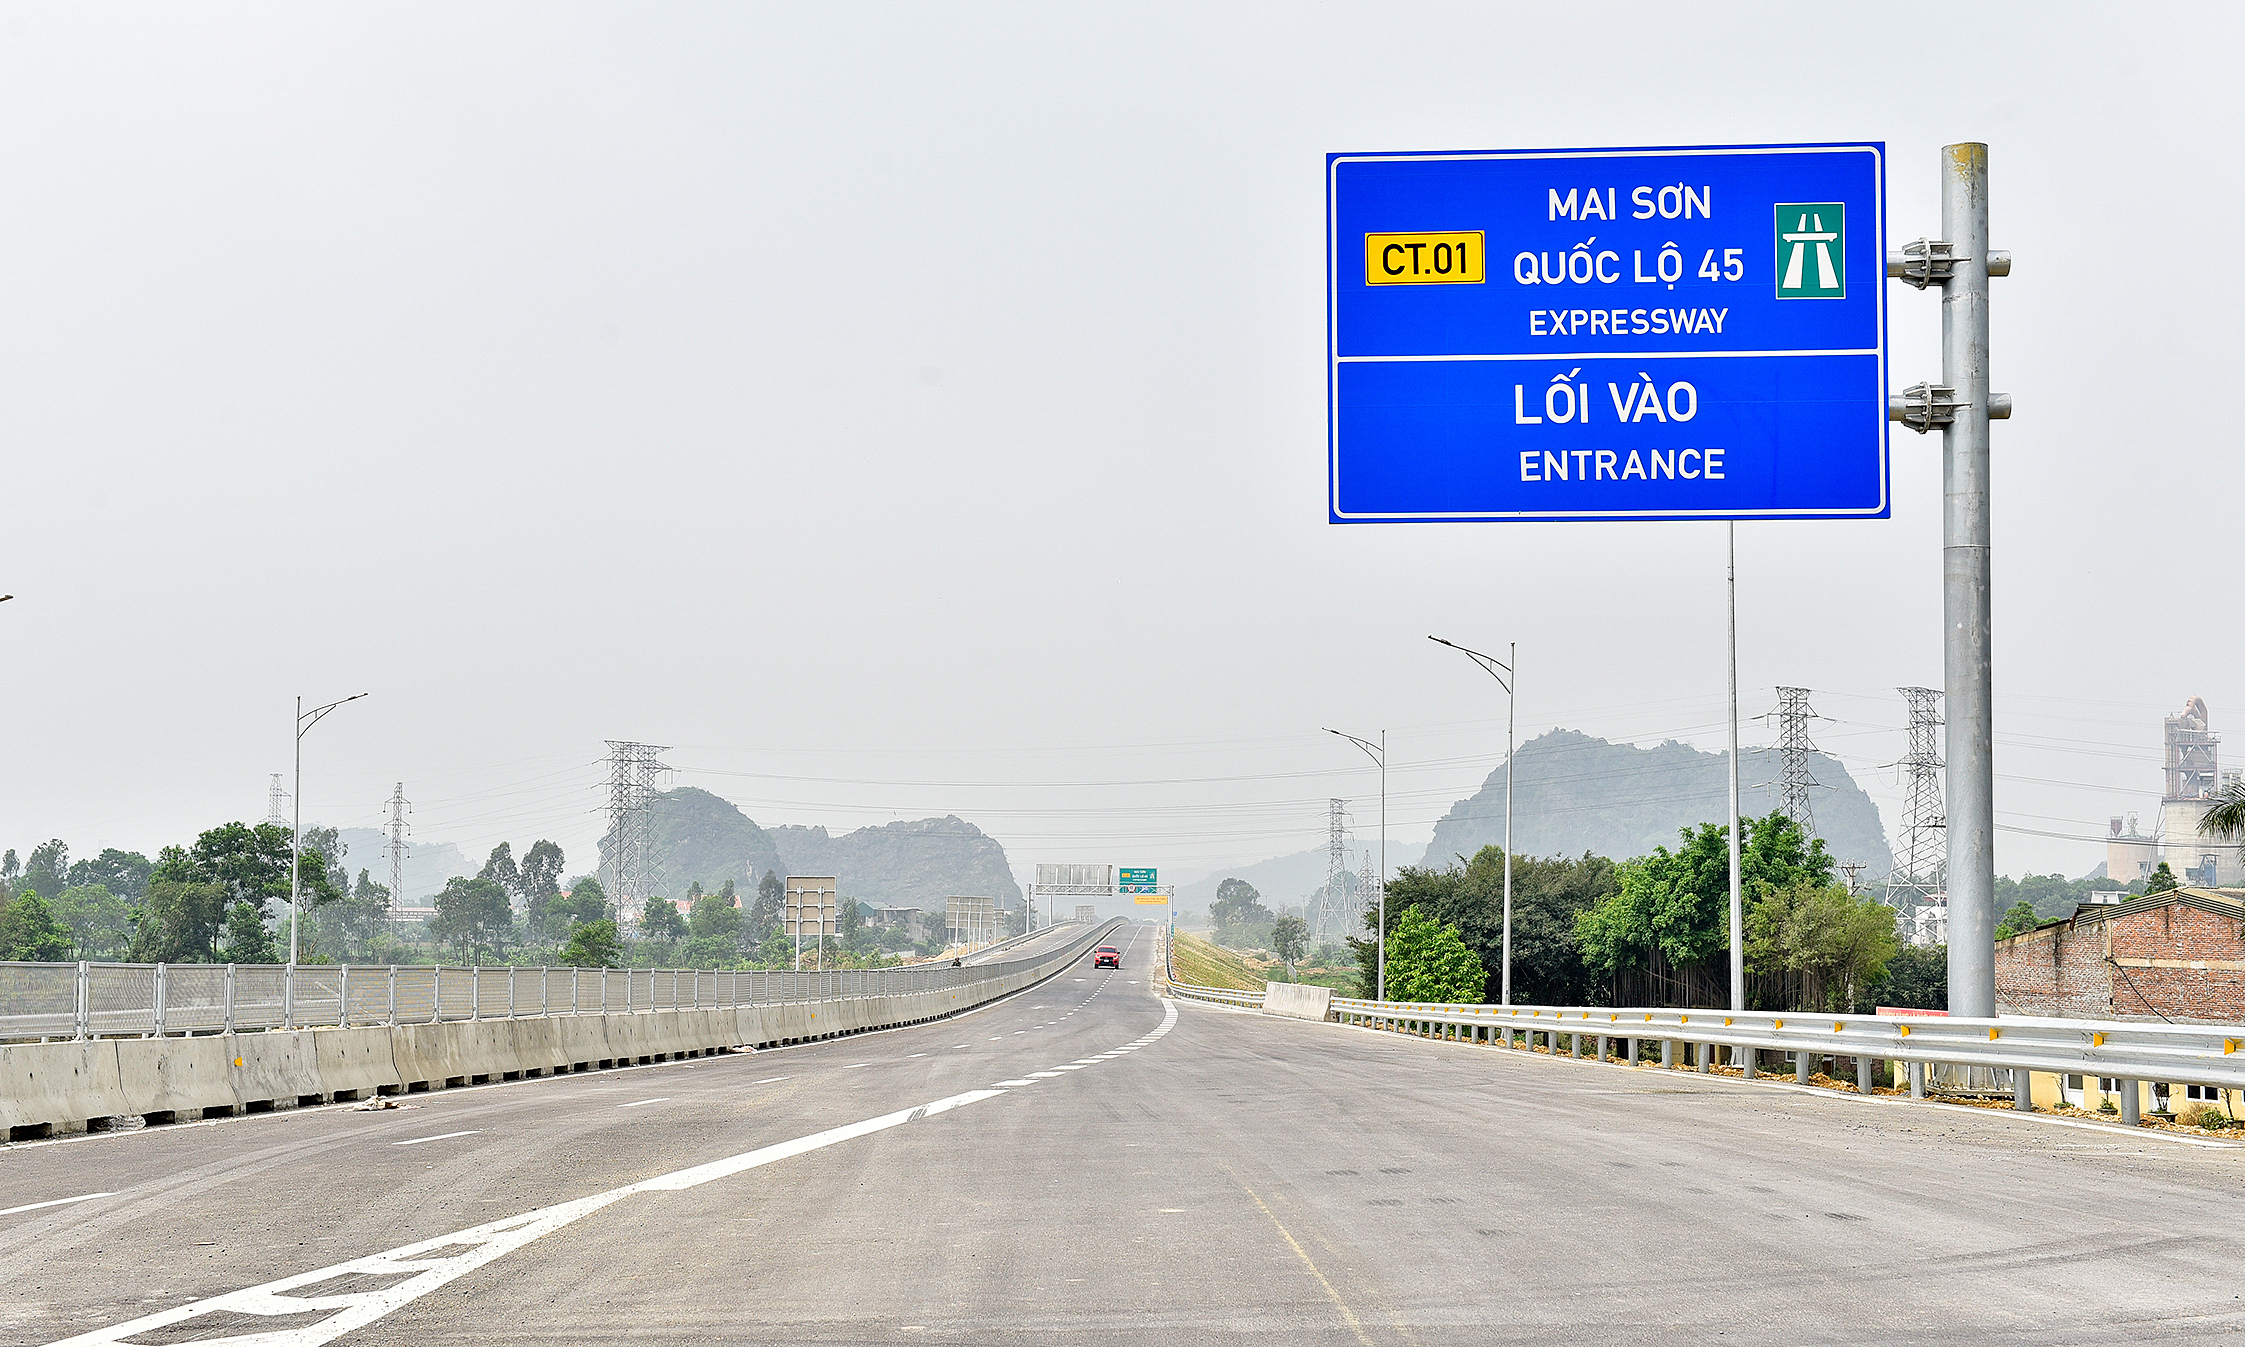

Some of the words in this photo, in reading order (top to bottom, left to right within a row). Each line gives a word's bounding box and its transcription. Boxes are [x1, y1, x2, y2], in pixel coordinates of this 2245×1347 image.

[1549, 188, 1616, 220] MAI
[1632, 183, 1711, 219] SƠN
[1382, 243, 1469, 275] CT.01
[1514, 238, 1620, 284] QUỐC
[1635, 241, 1683, 290] LỘ
[1698, 249, 1744, 281] 45
[1530, 308, 1729, 335] EXPRESSWAY
[1515, 368, 1589, 424] LỐI
[1608, 372, 1698, 422] VÀO
[1521, 449, 1725, 481] ENTRANCE
